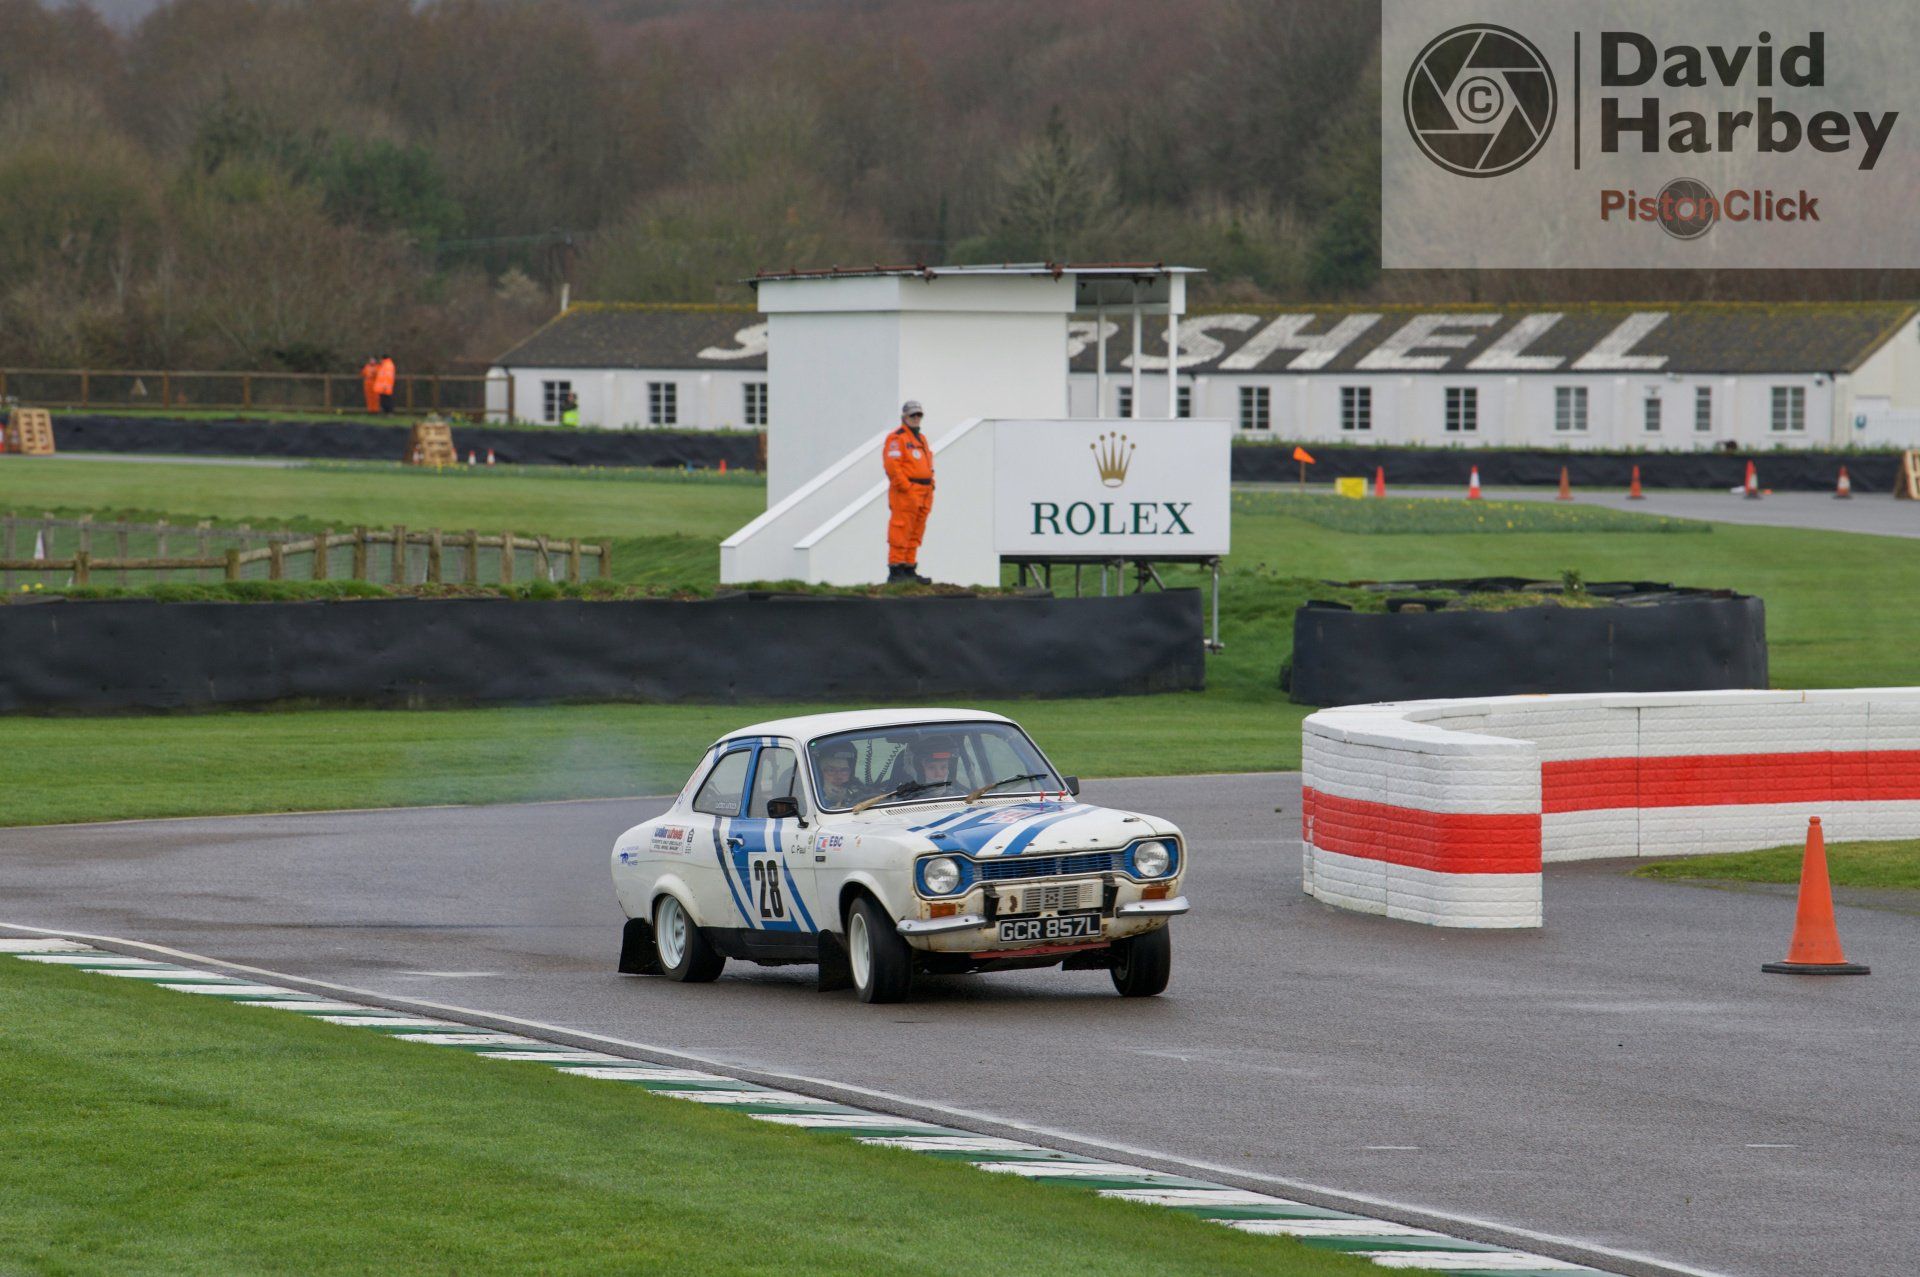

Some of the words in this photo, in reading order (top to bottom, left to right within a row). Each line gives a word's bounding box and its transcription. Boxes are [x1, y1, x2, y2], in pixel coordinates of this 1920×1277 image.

[1120, 312, 1671, 370] SHELL
[1030, 501, 1194, 535] ROLEX
[829, 835, 844, 848] EBC
[753, 859, 785, 918] 28
[1001, 921, 1041, 940] GCR
[1046, 917, 1099, 938] 857L
